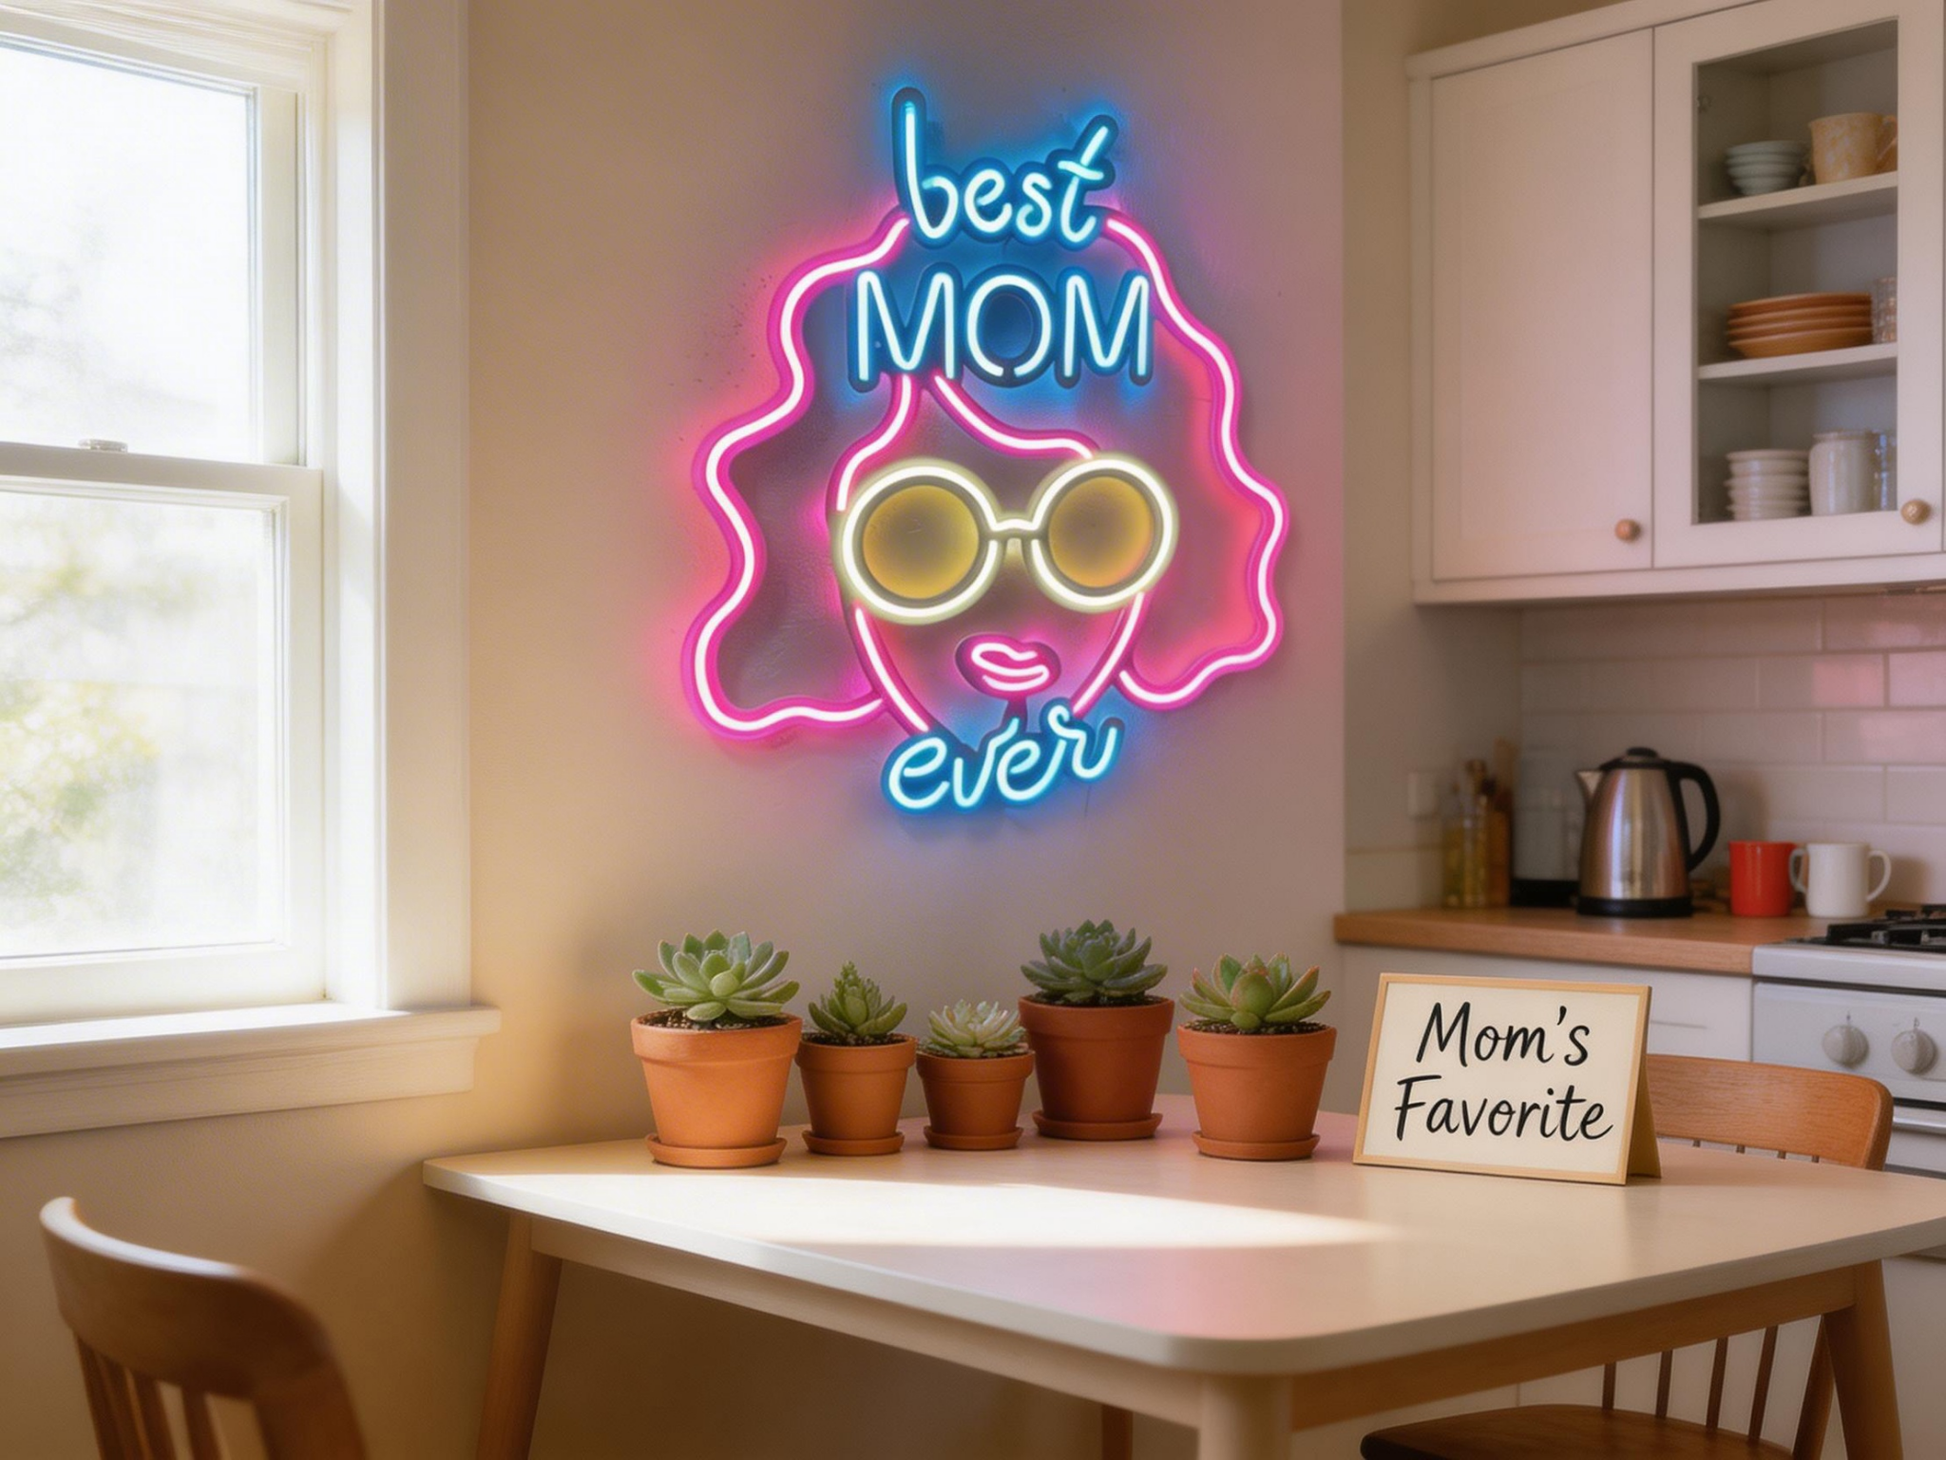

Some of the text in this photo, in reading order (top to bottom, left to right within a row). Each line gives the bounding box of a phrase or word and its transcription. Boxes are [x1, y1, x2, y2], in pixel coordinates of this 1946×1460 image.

[905, 101, 1108, 243] best
[857, 270, 1149, 381] MOM
[888, 705, 1118, 809] ever
[1415, 1001, 1590, 1067] Mom's
[1394, 1074, 1614, 1141] Favorite
